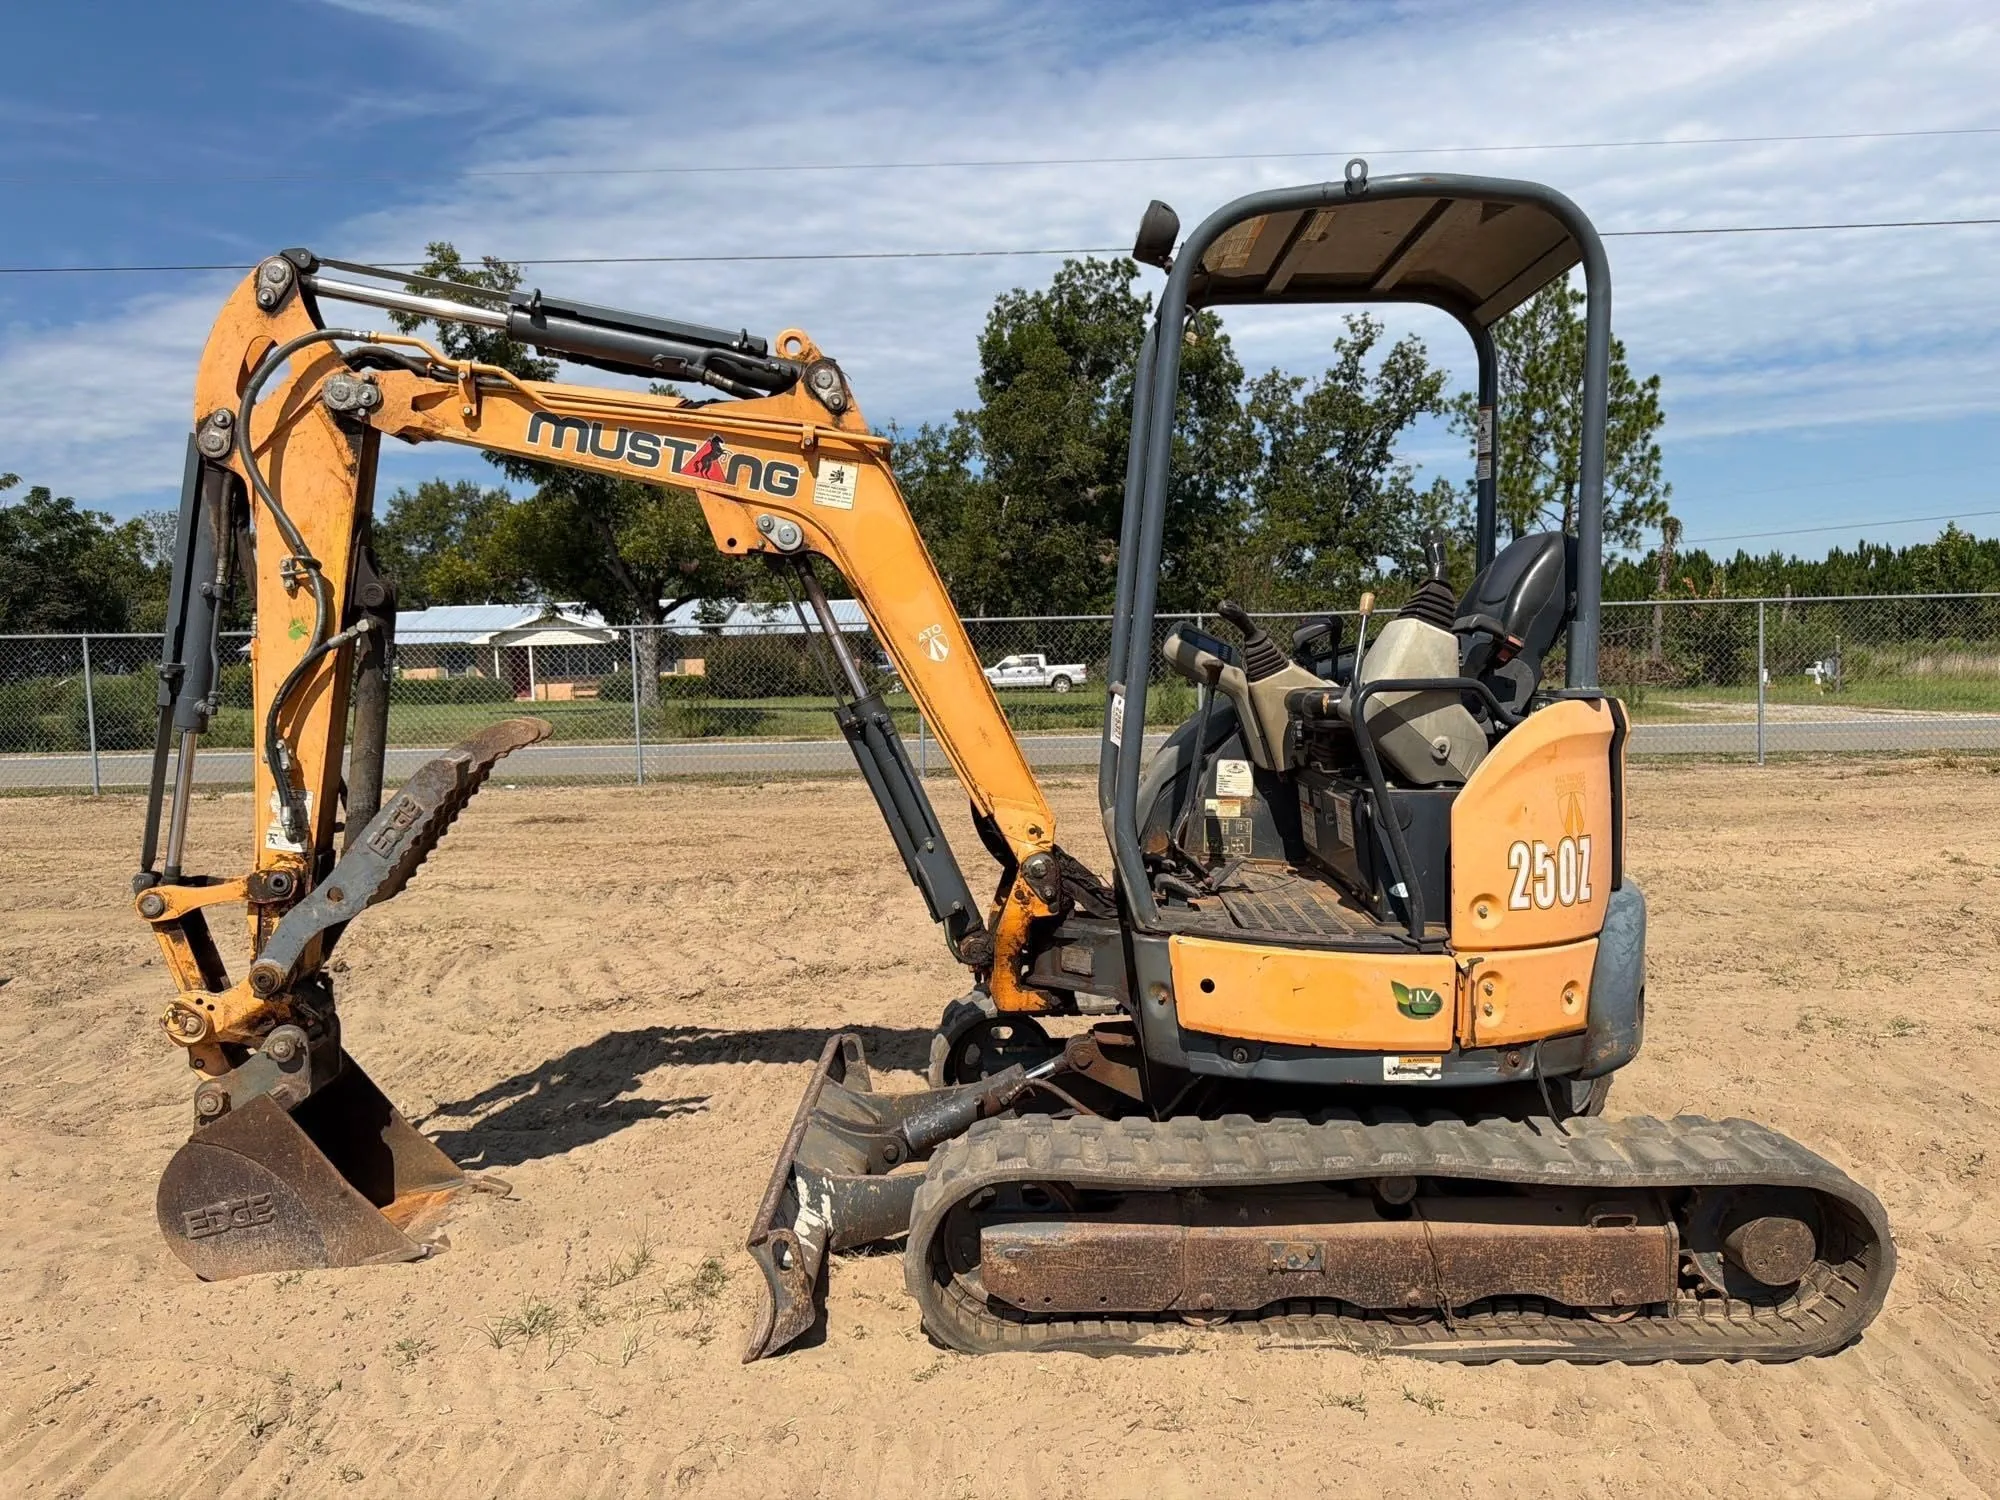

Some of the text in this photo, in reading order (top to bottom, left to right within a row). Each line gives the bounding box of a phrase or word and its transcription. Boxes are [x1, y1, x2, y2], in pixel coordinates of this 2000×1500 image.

[527, 410, 802, 498] MUSTANG
[366, 794, 424, 859] EDGE
[1507, 834, 1592, 911] 250Z
[182, 1191, 278, 1240] EDGE
